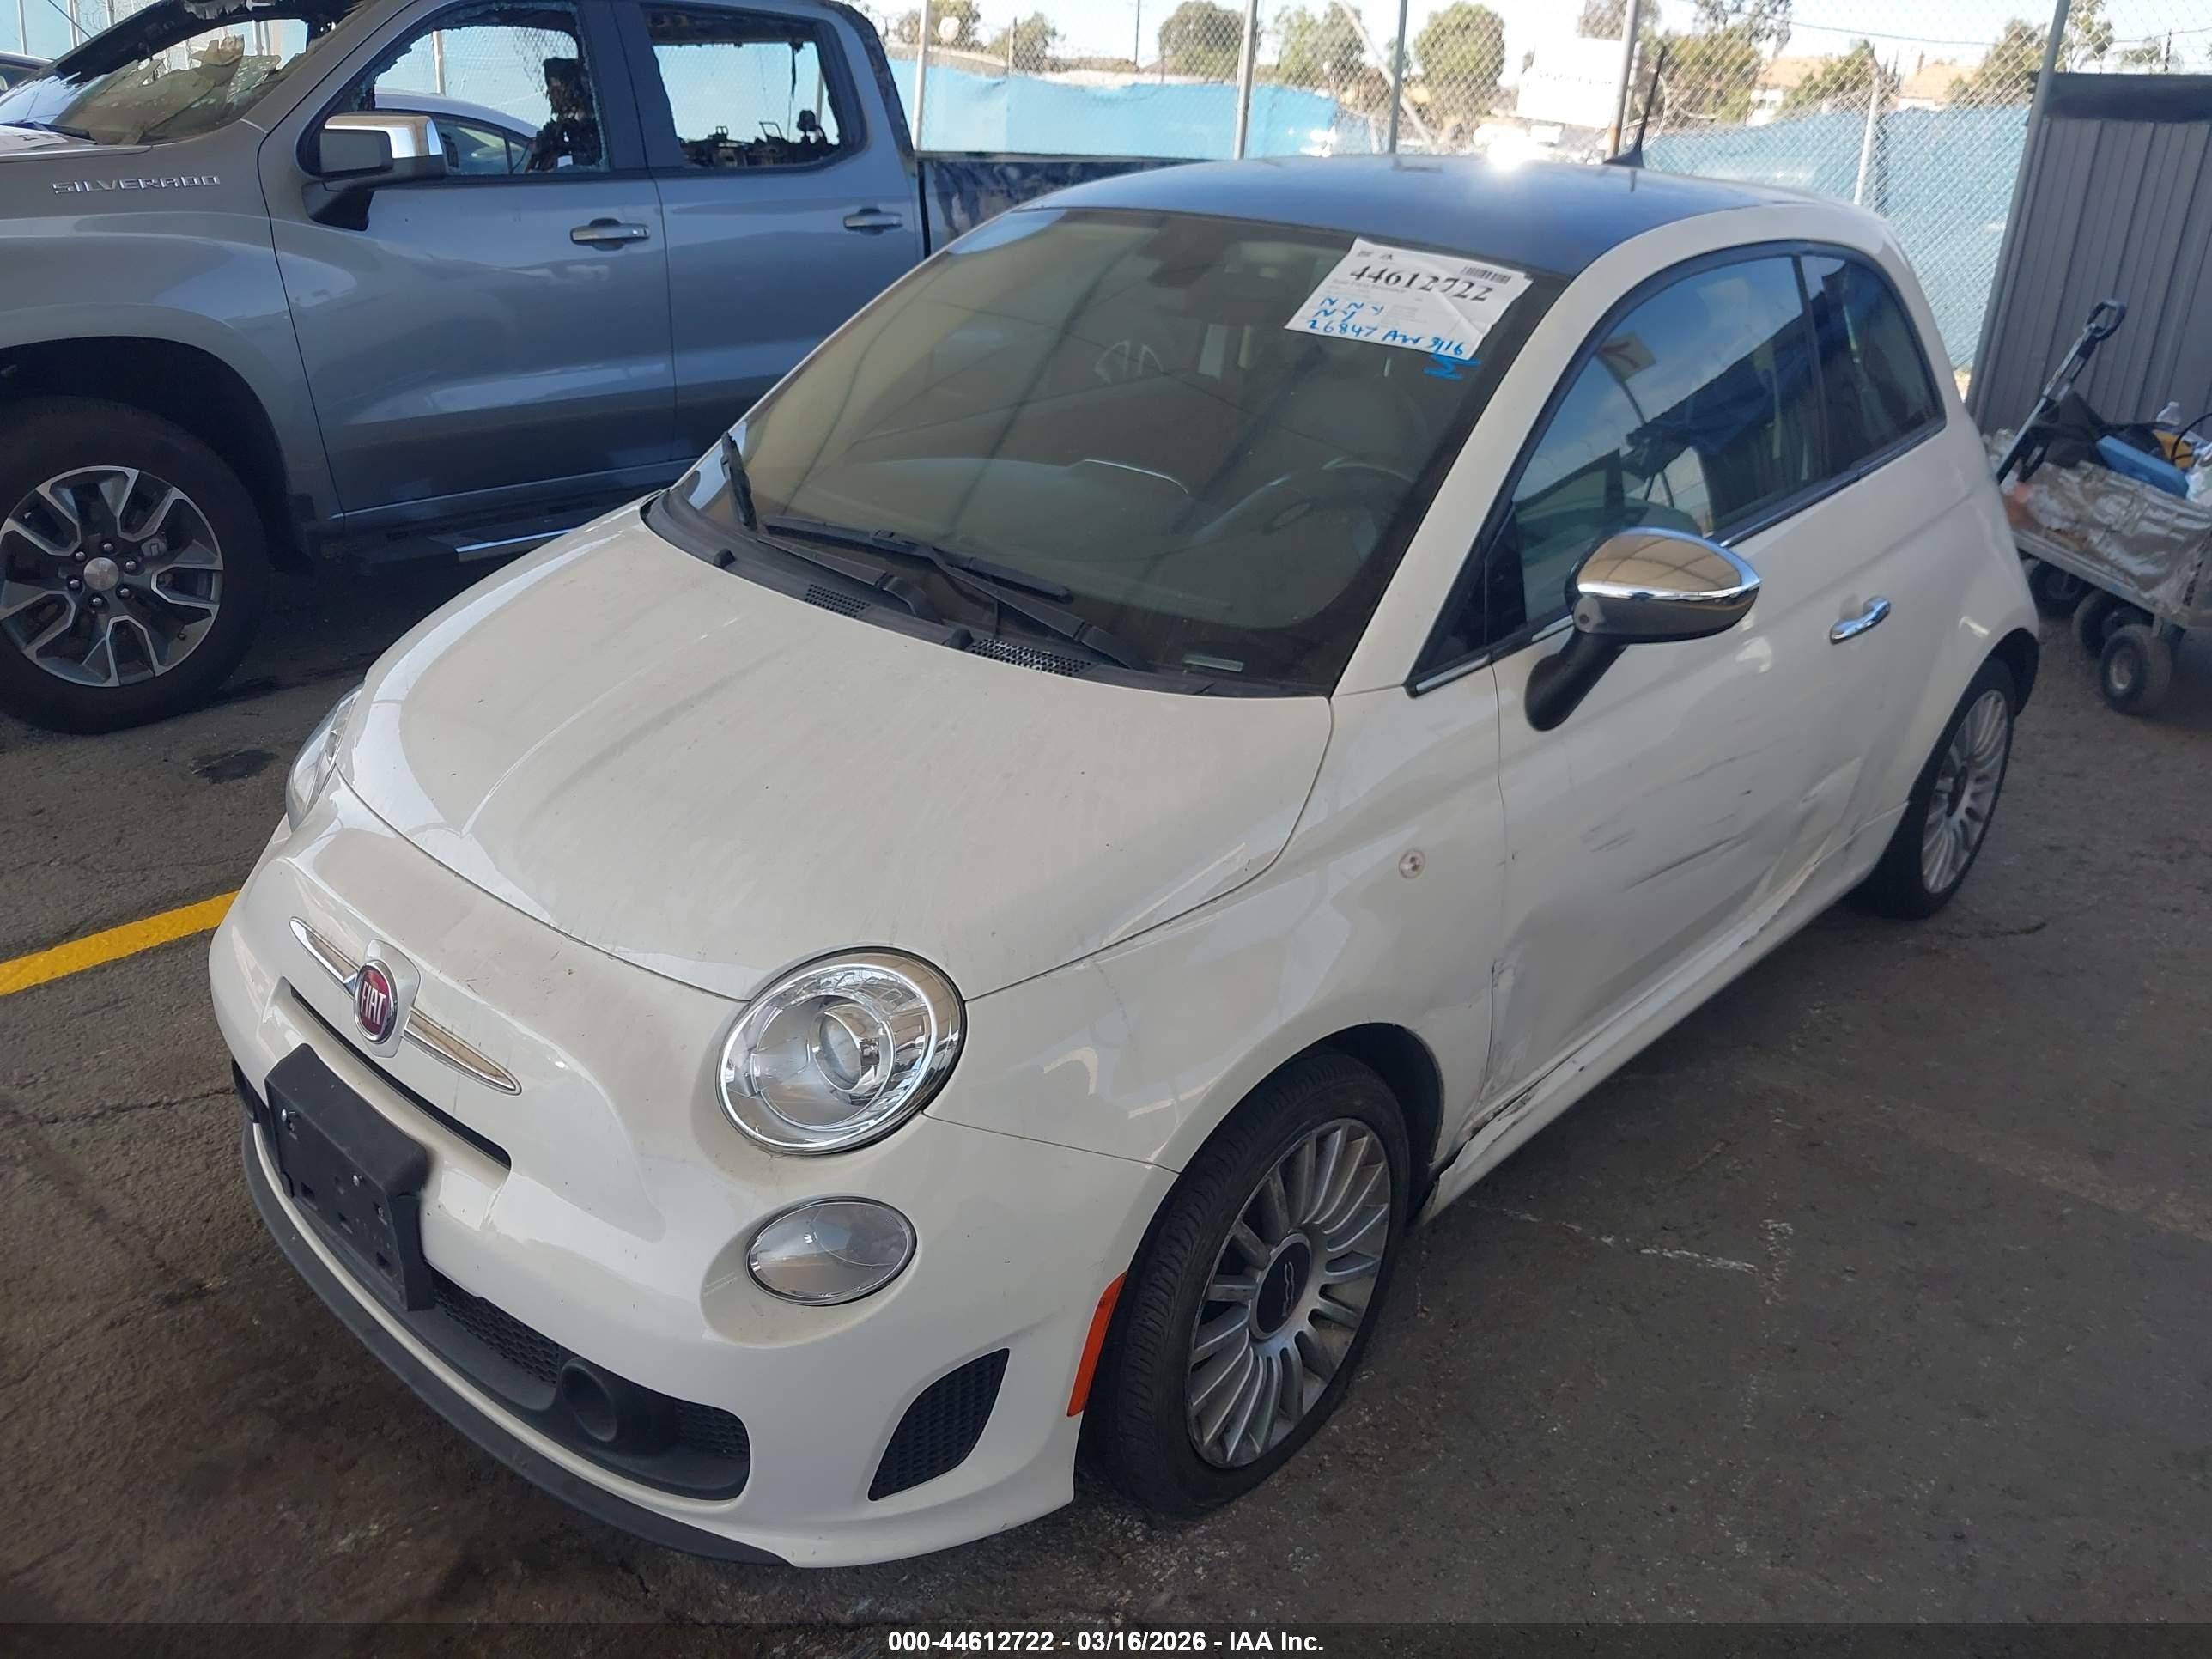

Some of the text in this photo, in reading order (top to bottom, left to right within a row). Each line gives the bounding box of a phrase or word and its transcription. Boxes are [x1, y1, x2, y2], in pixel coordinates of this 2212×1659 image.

[52, 174, 222, 196] SILVERADO
[1349, 265, 1494, 302] 44612722
[1307, 319, 1378, 338] 26847
[361, 981, 386, 1025] FIAT
